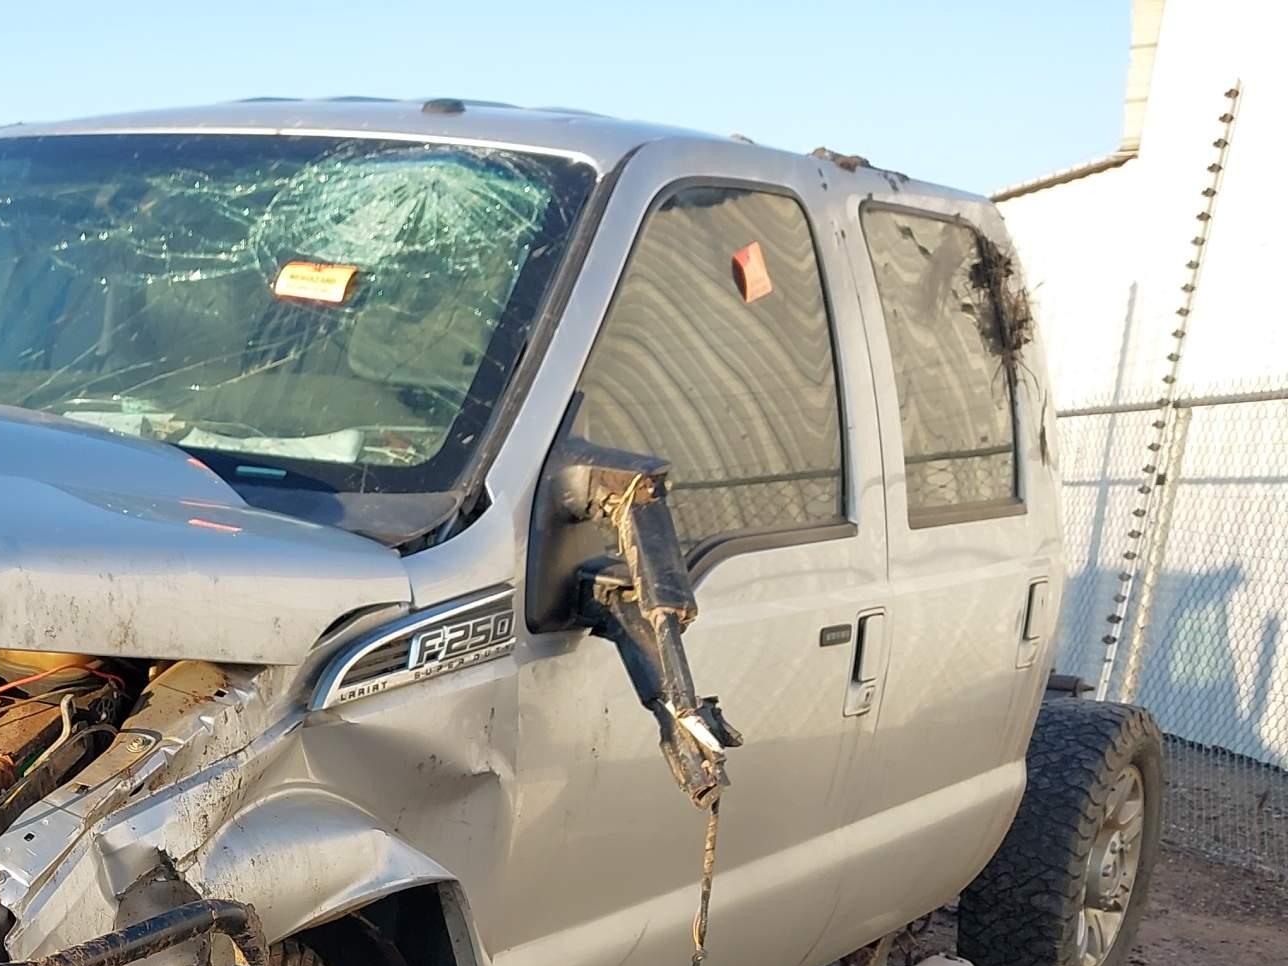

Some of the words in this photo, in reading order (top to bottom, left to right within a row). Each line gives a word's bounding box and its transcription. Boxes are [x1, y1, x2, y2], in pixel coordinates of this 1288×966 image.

[415, 608, 515, 666] F-250
[414, 657, 465, 680] SUPER
[340, 681, 388, 702] LARIAT
